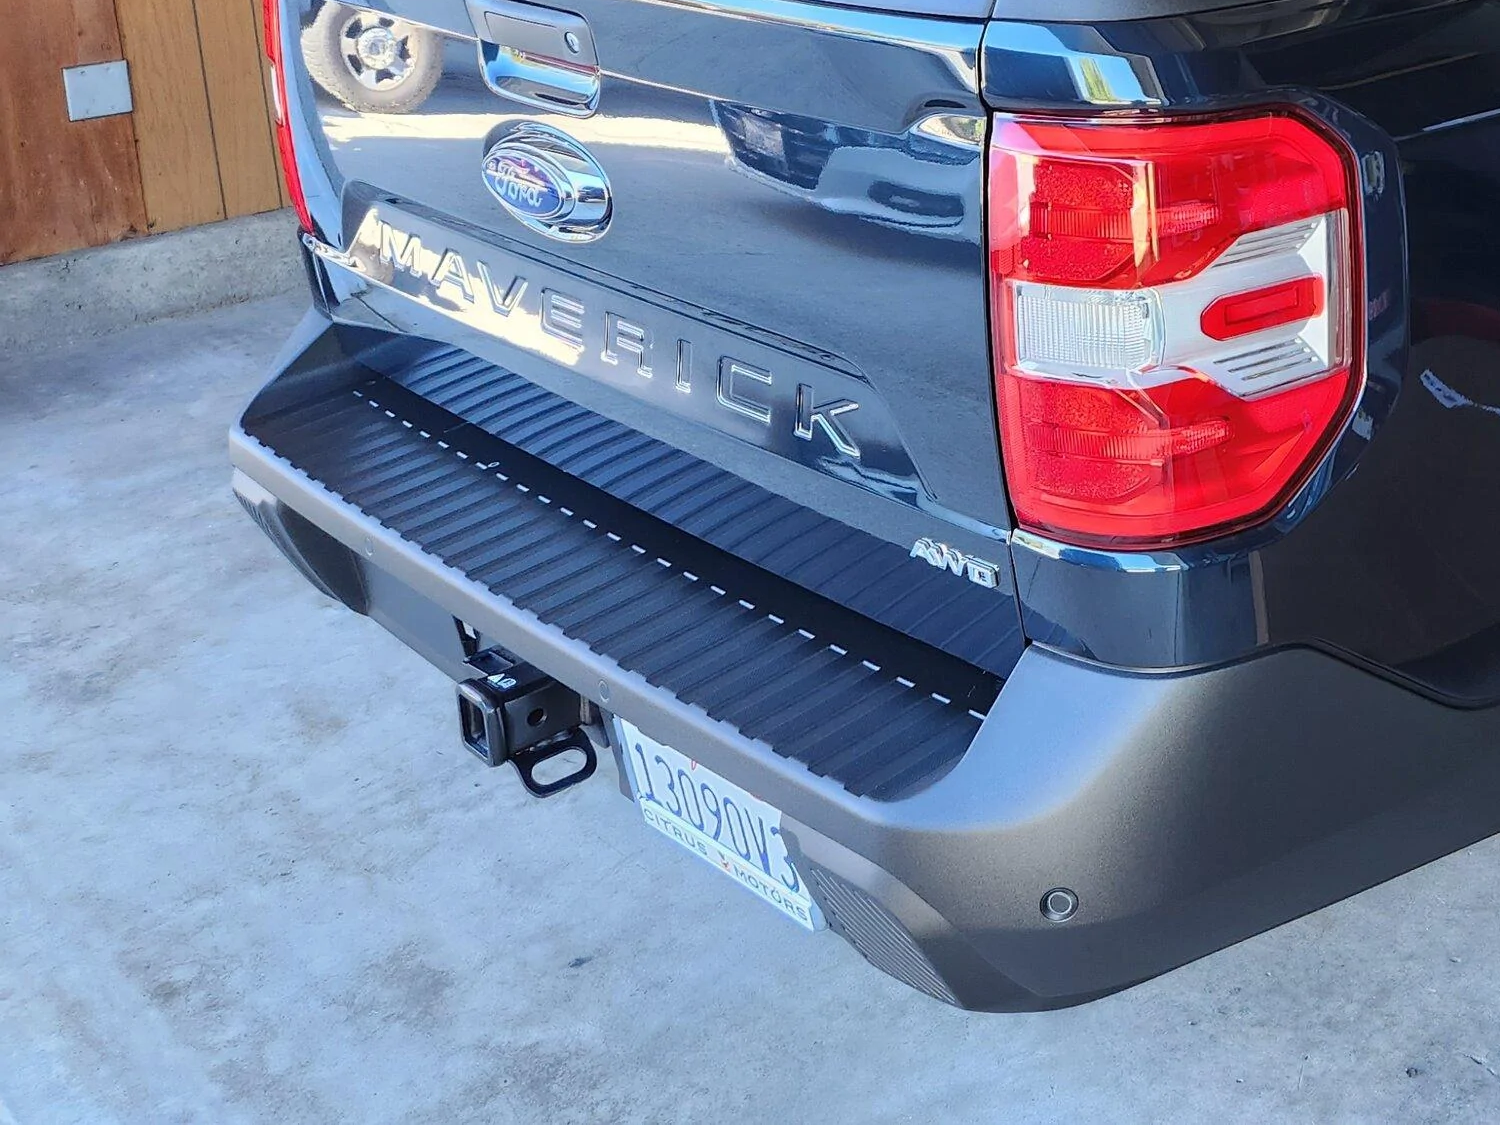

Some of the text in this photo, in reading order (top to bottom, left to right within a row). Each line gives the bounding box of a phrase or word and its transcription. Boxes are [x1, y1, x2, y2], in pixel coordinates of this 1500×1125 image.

[494, 158, 544, 208] Ford
[378, 219, 862, 462] MAVERICK
[909, 537, 1000, 589] AWD
[634, 742, 801, 894] 13090V3
[643, 807, 808, 922] CITRUS MOTORS
